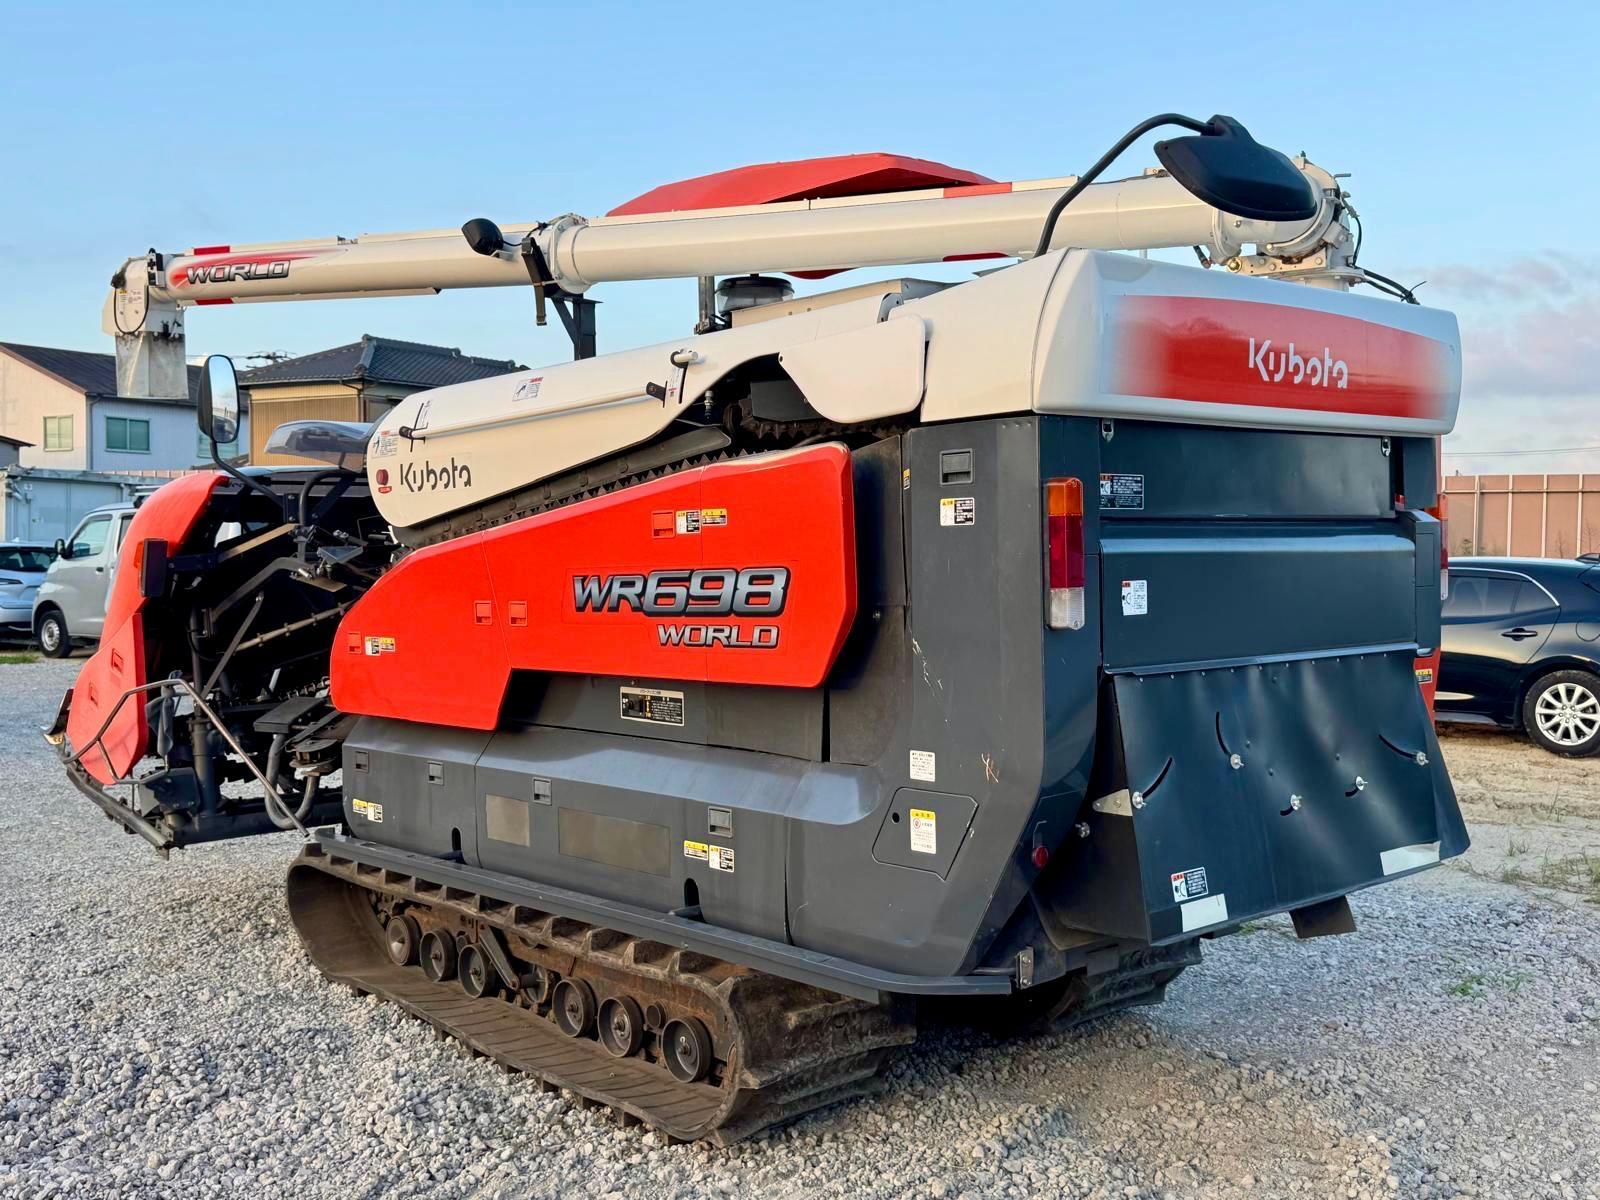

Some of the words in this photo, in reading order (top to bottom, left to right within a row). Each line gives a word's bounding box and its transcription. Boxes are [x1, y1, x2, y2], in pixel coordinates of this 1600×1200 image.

[186, 261, 291, 284] WORLD
[1248, 338, 1348, 389] Kubota
[400, 457, 472, 492] Kubota
[573, 566, 790, 617] WR698
[657, 624, 779, 648] WORLD
